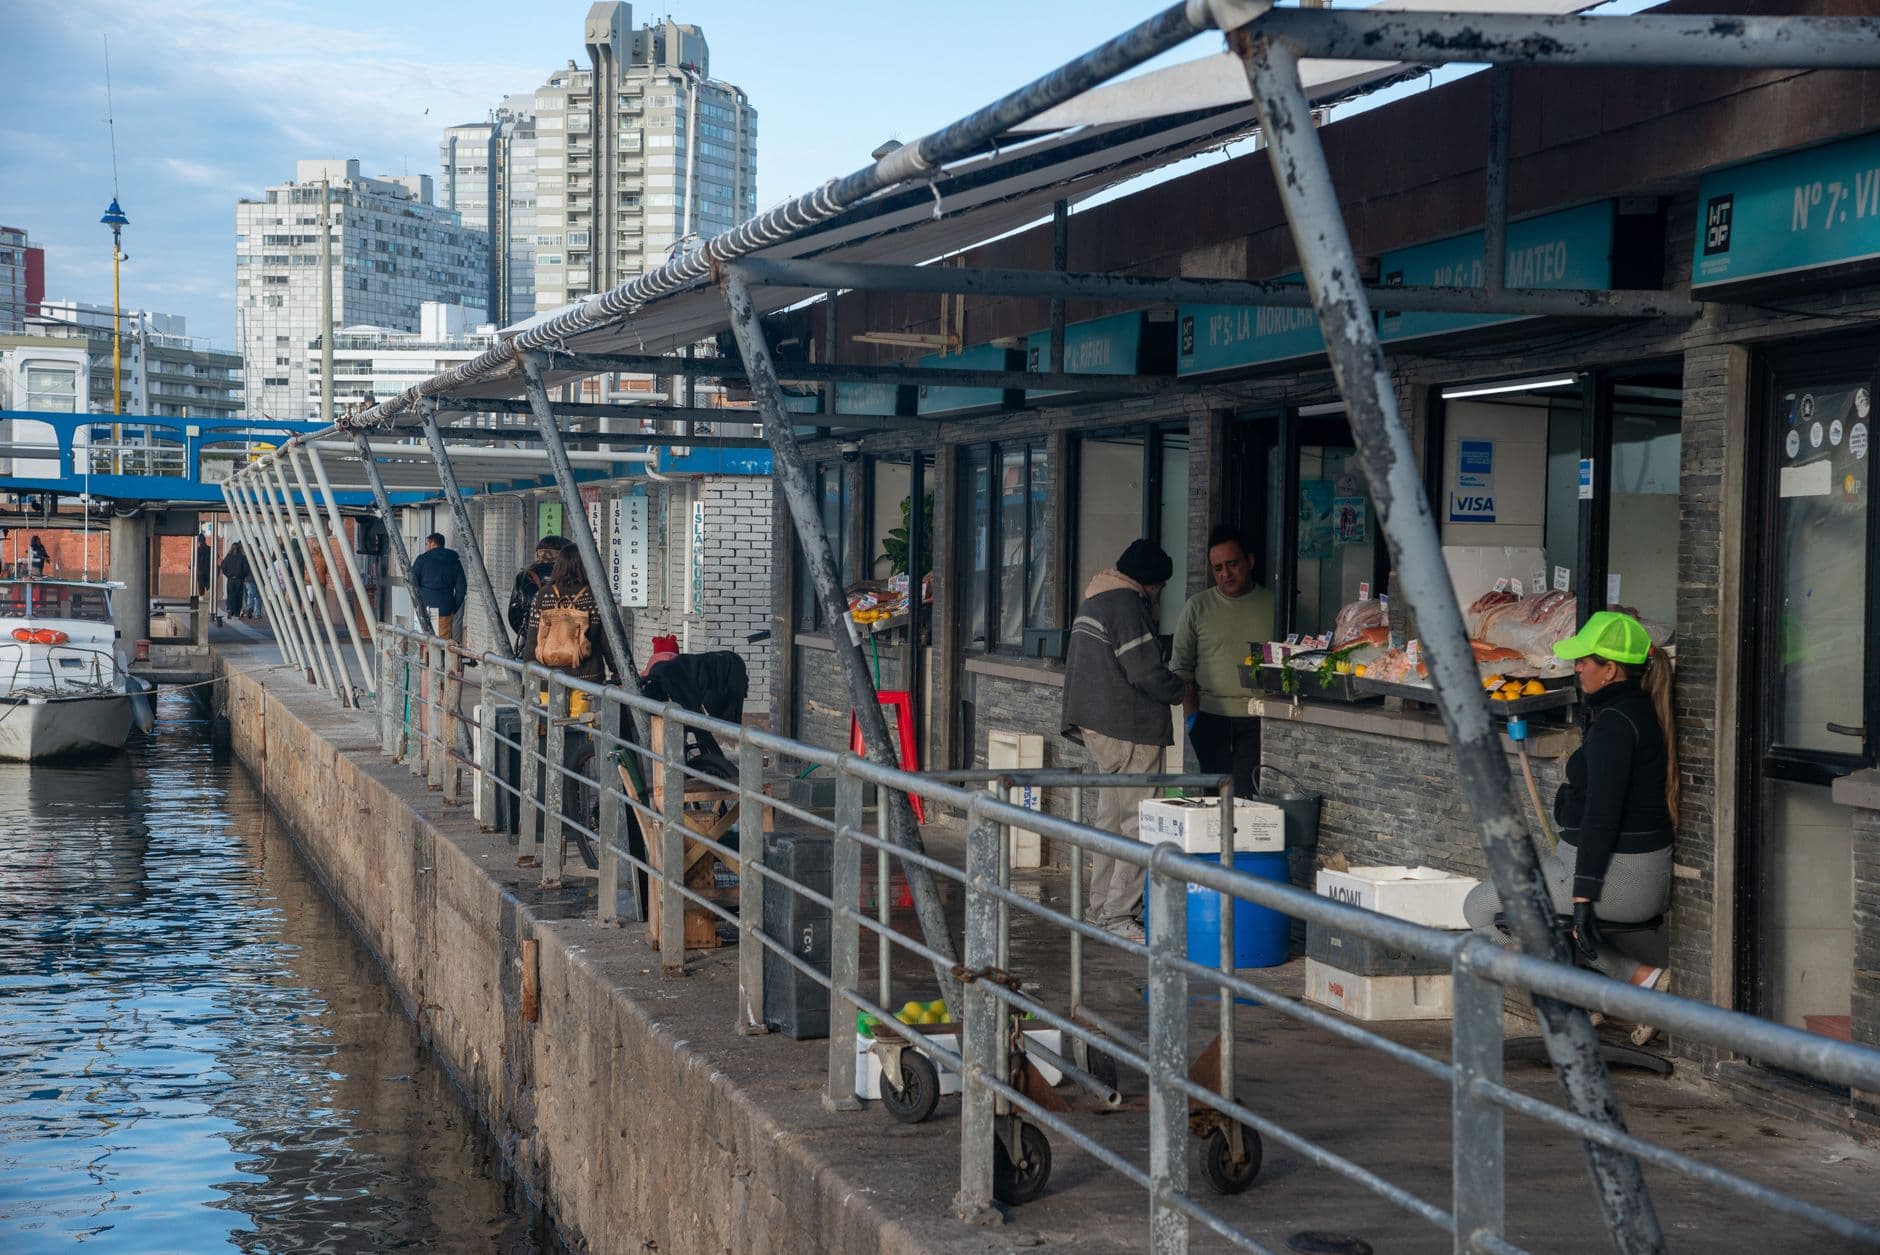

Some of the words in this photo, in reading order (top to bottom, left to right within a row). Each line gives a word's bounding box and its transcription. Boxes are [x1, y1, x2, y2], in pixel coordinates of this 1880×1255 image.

[1824, 181, 1848, 231] 7:
[1508, 240, 1567, 288] MATEO
[1237, 309, 1250, 341] LA
[613, 501, 621, 534] ISLA
[630, 501, 639, 531] ISLA
[1457, 496, 1494, 511] VISA
[546, 507, 554, 534] ISLA
[693, 503, 703, 545] ISLA
[612, 538, 622, 546] DE
[630, 541, 639, 554] DE
[630, 564, 639, 601] LOBOS
[693, 555, 703, 617] LOBOS
